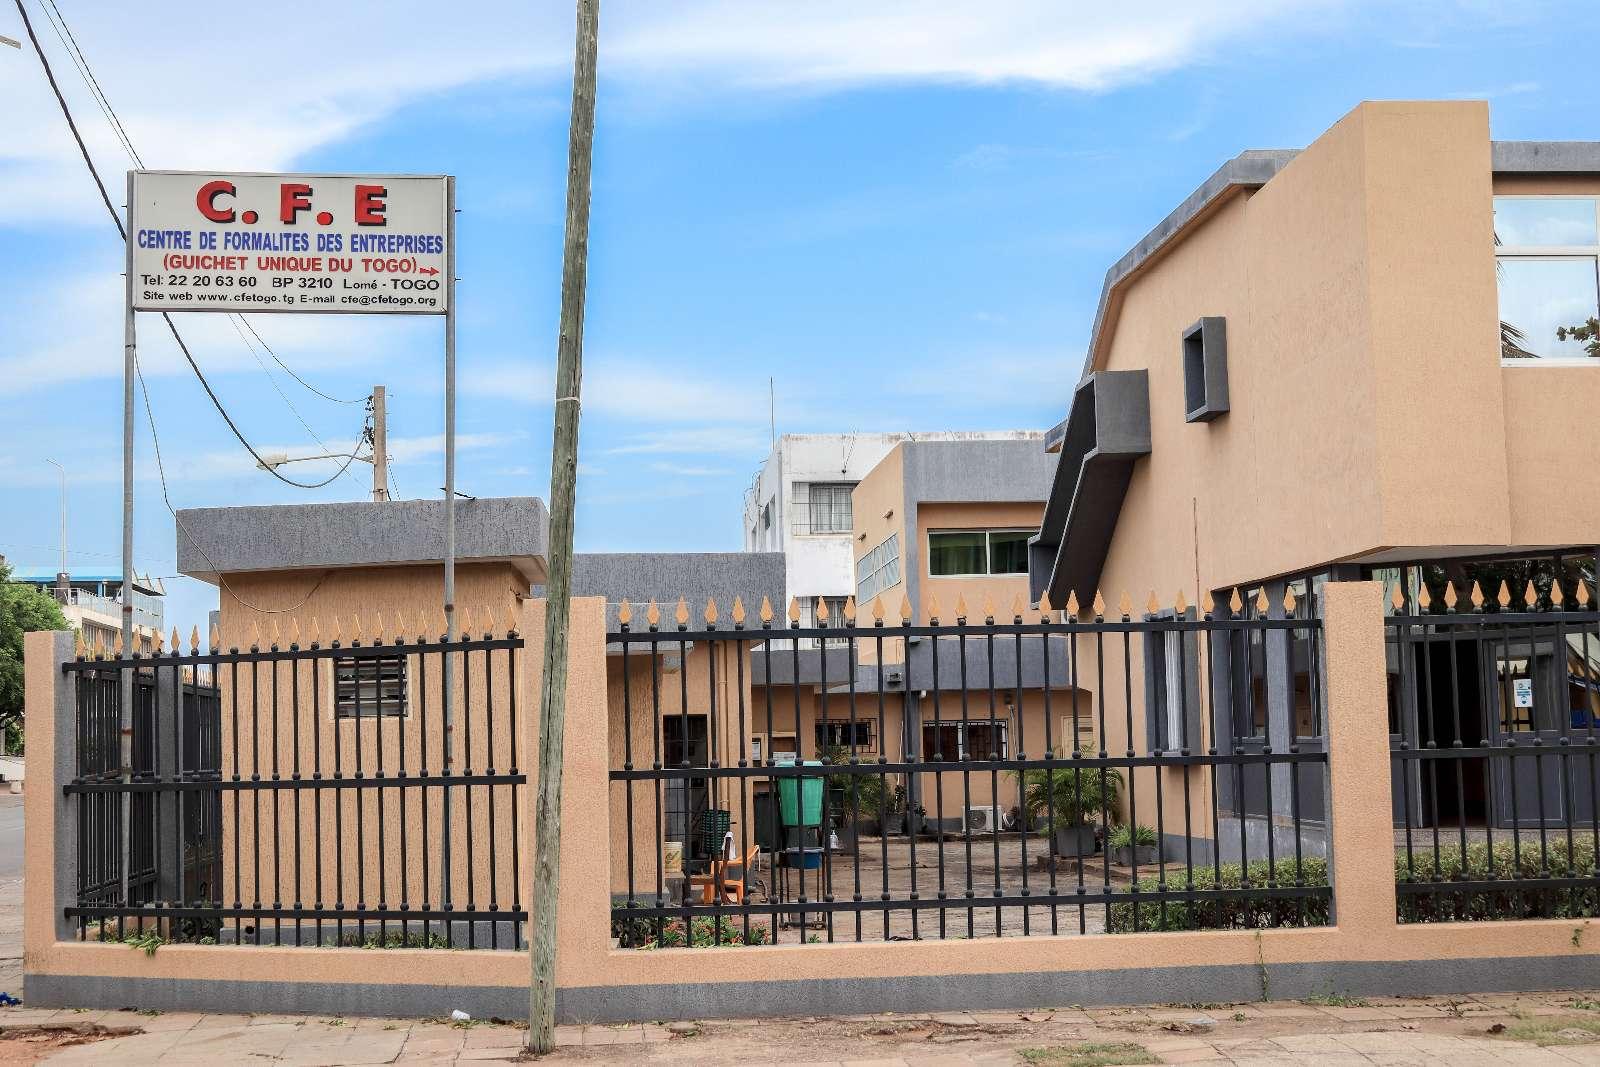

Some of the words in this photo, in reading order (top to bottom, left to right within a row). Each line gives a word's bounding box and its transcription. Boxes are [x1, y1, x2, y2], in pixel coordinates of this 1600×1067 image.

[355, 184, 388, 227] E
[138, 229, 192, 250] CENTRE
[199, 231, 217, 250] DE
[224, 231, 309, 252] FORMALITES
[317, 233, 343, 252] DES
[351, 234, 443, 254] ENTREPRISES
[163, 253, 248, 271] (GUICHET
[257, 256, 322, 272] UNIQUE
[328, 257, 353, 273] DU
[361, 257, 417, 273] TOGO)
[141, 275, 164, 285] Tel:
[168, 275, 187, 286] 22
[192, 276, 211, 286] 20
[215, 276, 234, 287] 63
[238, 276, 257, 287] 60
[272, 277, 294, 288] BP
[298, 277, 333, 289] 3210
[343, 279, 378, 290] Lomé
[390, 278, 440, 291] TOGO
[143, 291, 165, 300] Site
[169, 291, 193, 301] web
[197, 292, 294, 305] www.cfetogo.tg
[300, 294, 335, 303] E-mail
[341, 294, 437, 306] cfe@cfetogo.org
